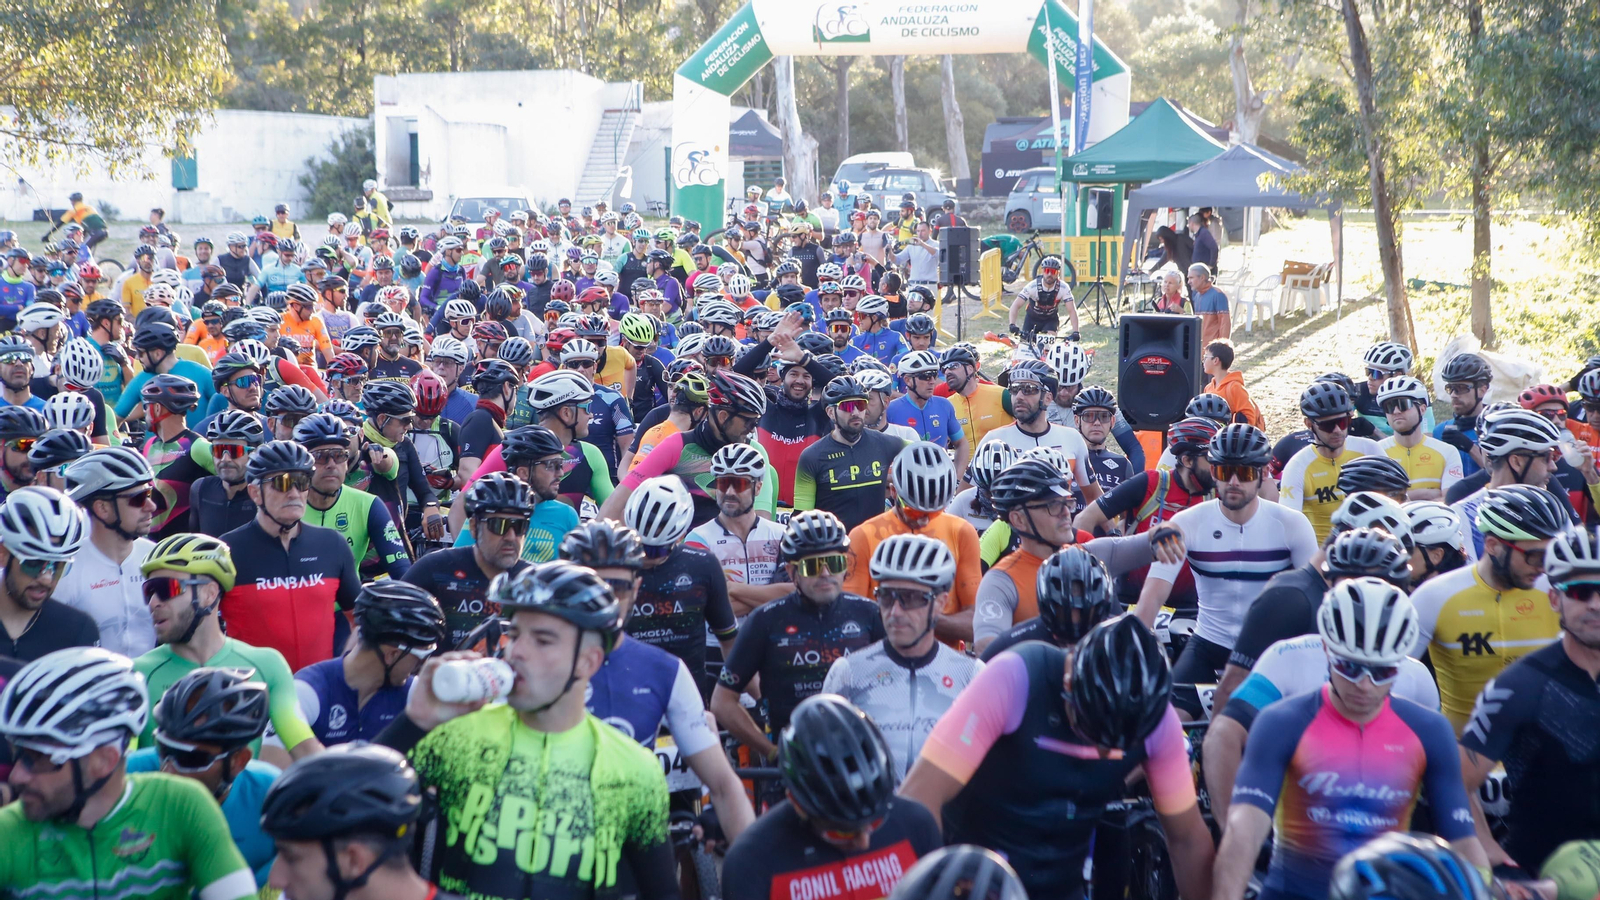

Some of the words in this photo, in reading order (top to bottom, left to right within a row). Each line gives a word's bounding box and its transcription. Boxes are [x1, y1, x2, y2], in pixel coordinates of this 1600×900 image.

[898, 3, 979, 13] FEDERACIÓN
[880, 15, 949, 26] ANDALUZA
[901, 28, 918, 37] DE
[921, 26, 980, 37] CICLISMO
[704, 21, 749, 66] FEDERACIÓN
[701, 42, 740, 81] ANDALUZA
[717, 66, 729, 77] DE
[728, 33, 762, 67] CICLISMO
[1031, 138, 1070, 149] ATIA
[1037, 336, 1055, 345] 238
[542, 390, 575, 408] S-WORKS
[842, 852, 903, 892] RACING
[789, 870, 842, 900] CONIL
